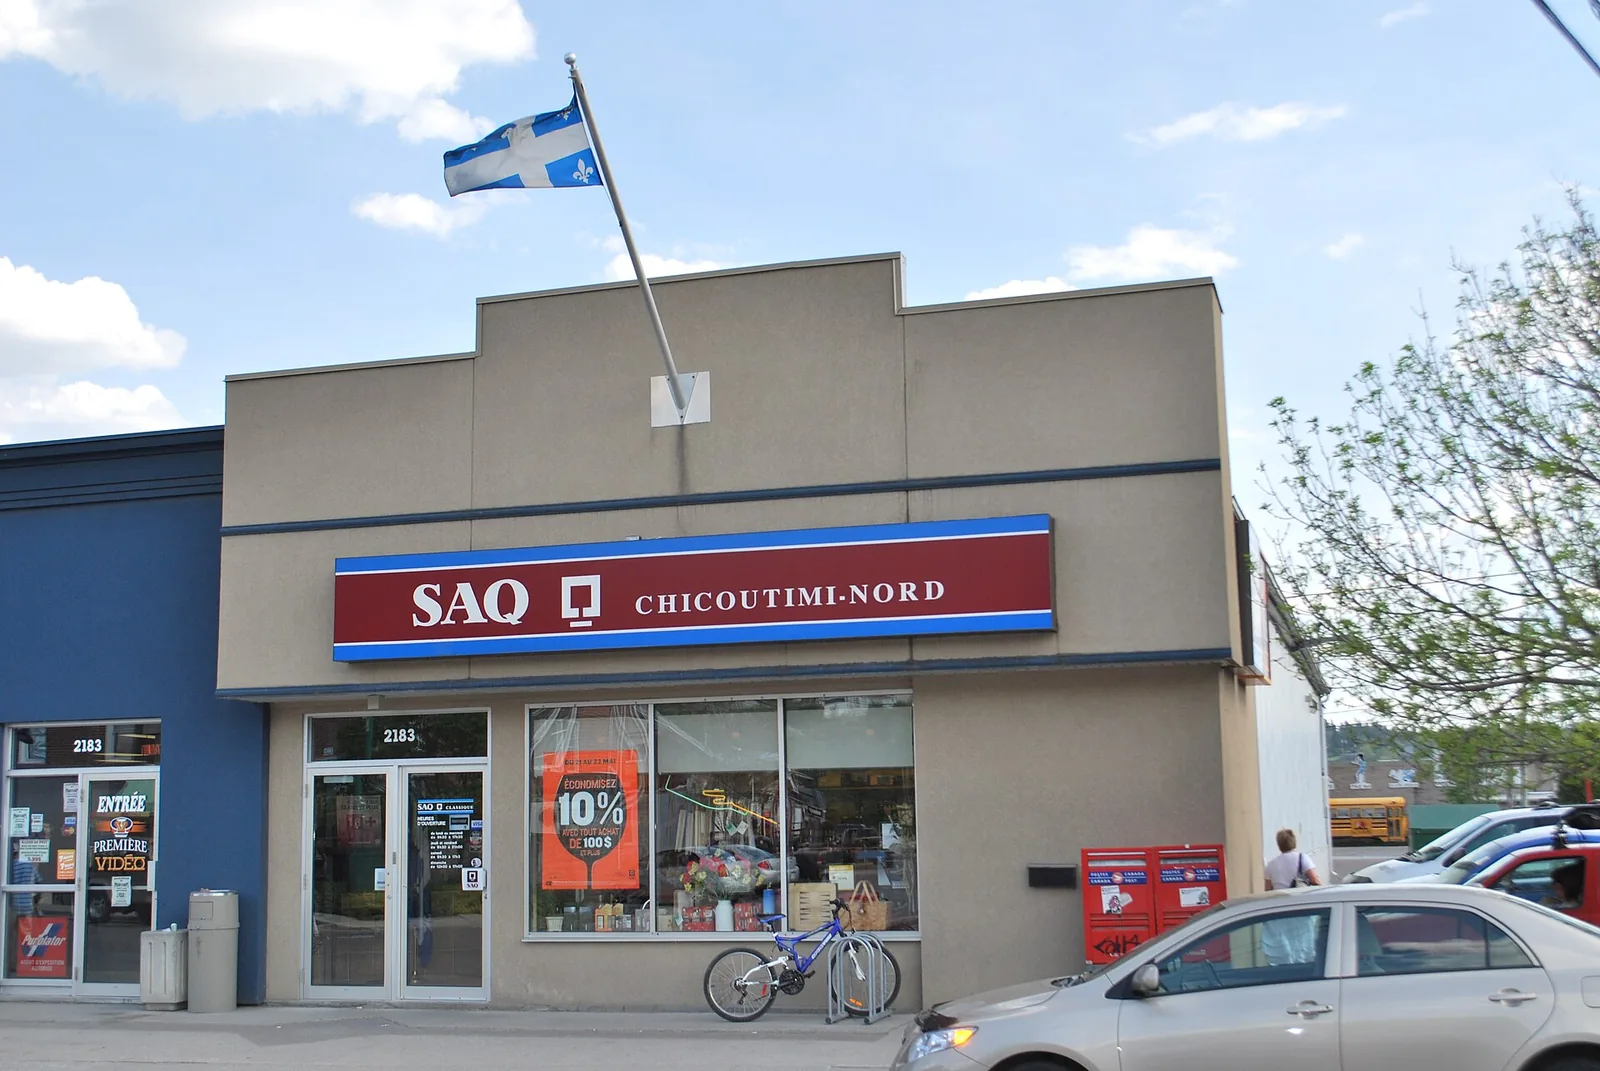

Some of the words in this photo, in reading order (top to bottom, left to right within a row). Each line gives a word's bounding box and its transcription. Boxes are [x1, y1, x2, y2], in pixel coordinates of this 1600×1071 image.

[412, 578, 529, 627] SAQ
[635, 579, 945, 616] CHICOUTIMI-NORD
[383, 728, 416, 743] 2183
[73, 738, 102, 753] 2183
[564, 778, 617, 789] ÉCONOMISEZ
[97, 791, 147, 813] ENTRÉE
[417, 803, 433, 811] SAQ
[558, 791, 624, 827] 10%
[562, 829, 579, 837] AVEC
[580, 828, 598, 836] TOUT
[599, 827, 620, 836] ACHAT
[93, 838, 148, 853] PREMIÈRE
[569, 838, 583, 849] DE
[583, 836, 612, 849] 100$
[95, 853, 146, 871] VIDÉO
[21, 934, 67, 946] Purolator
